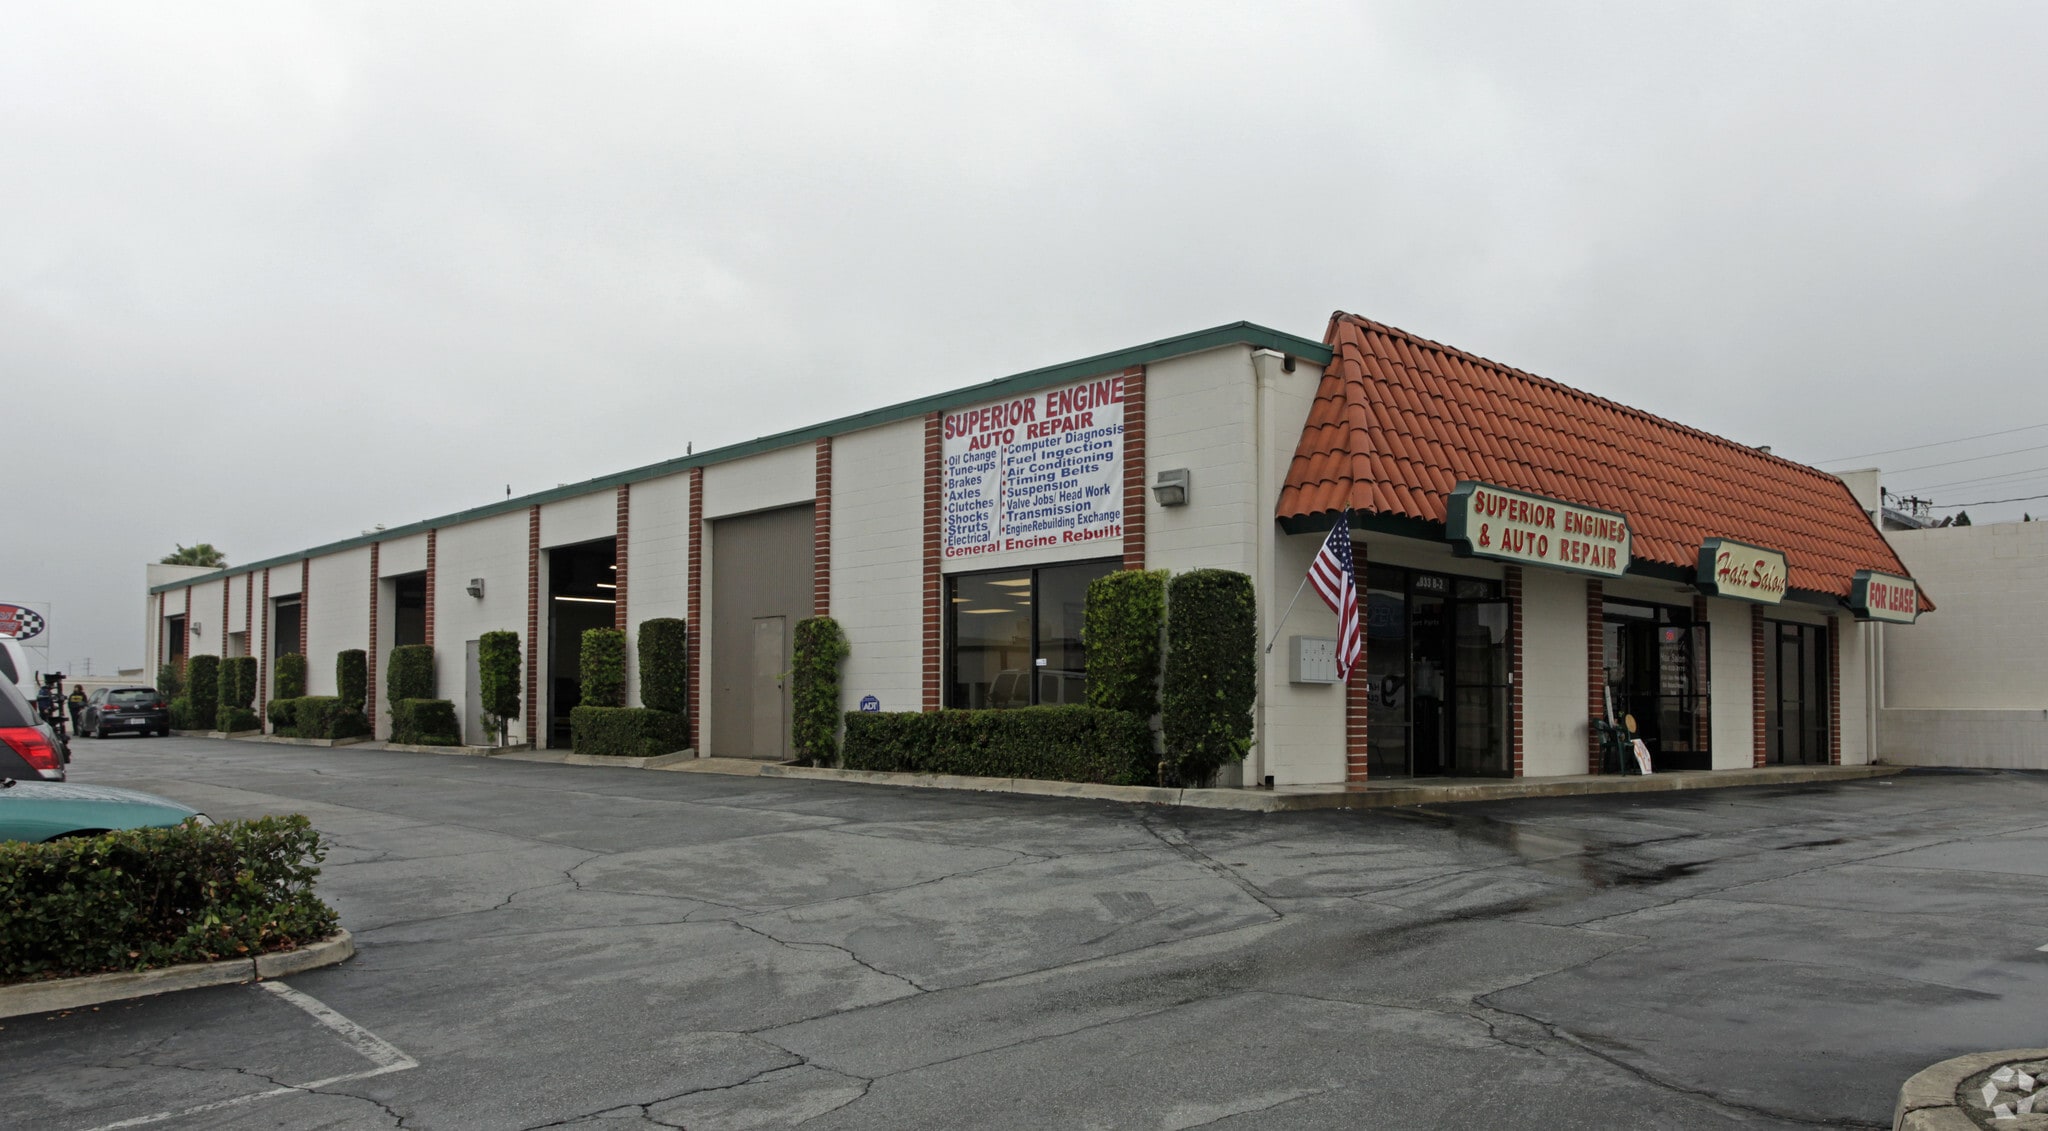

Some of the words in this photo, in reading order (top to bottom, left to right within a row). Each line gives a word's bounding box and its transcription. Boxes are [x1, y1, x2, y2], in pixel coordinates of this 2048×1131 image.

[945, 397, 1036, 440] SUPERIOR
[1046, 376, 1124, 418] ENGINE
[969, 429, 1015, 451] AUTO
[1027, 412, 1094, 440] REPAIR
[1008, 437, 1062, 454] Computer
[1065, 424, 1125, 443] Diagnosis
[949, 455, 960, 466] Oil
[963, 450, 997, 463] Change
[1007, 453, 1036, 466] Fuel
[1041, 440, 1113, 459] Ingection
[949, 461, 996, 477] Tune-ups
[1007, 467, 1025, 477] Air
[1029, 451, 1114, 473] Conditioning
[949, 475, 982, 489] Brakes
[1008, 472, 1056, 486] Timing
[1061, 464, 1099, 477] Belts
[949, 489, 981, 501] Axles
[1007, 479, 1078, 498] Suspension
[1007, 498, 1030, 510] Valve
[1059, 488, 1082, 502] Head
[1085, 483, 1110, 498] Work
[948, 499, 994, 513] Clutches
[1007, 501, 1091, 521] Transmission
[1475, 490, 1556, 529] SUPERIOR
[1564, 511, 1626, 543] ENGINES
[948, 511, 989, 525] Shocks
[1077, 510, 1121, 525] Exchange
[948, 522, 988, 535] Struts
[948, 531, 991, 546] Electrical
[945, 540, 1000, 557] General
[1062, 525, 1122, 543] Rebuilt
[1479, 523, 1490, 547] &
[1500, 528, 1548, 557] AUTO
[1560, 538, 1616, 569] REPAIR
[1718, 552, 1748, 586] Hair
[1750, 560, 1785, 594] Salon
[1870, 581, 1887, 609] FOR
[1889, 585, 1914, 614] LEASE
[862, 702, 877, 711] ADT
